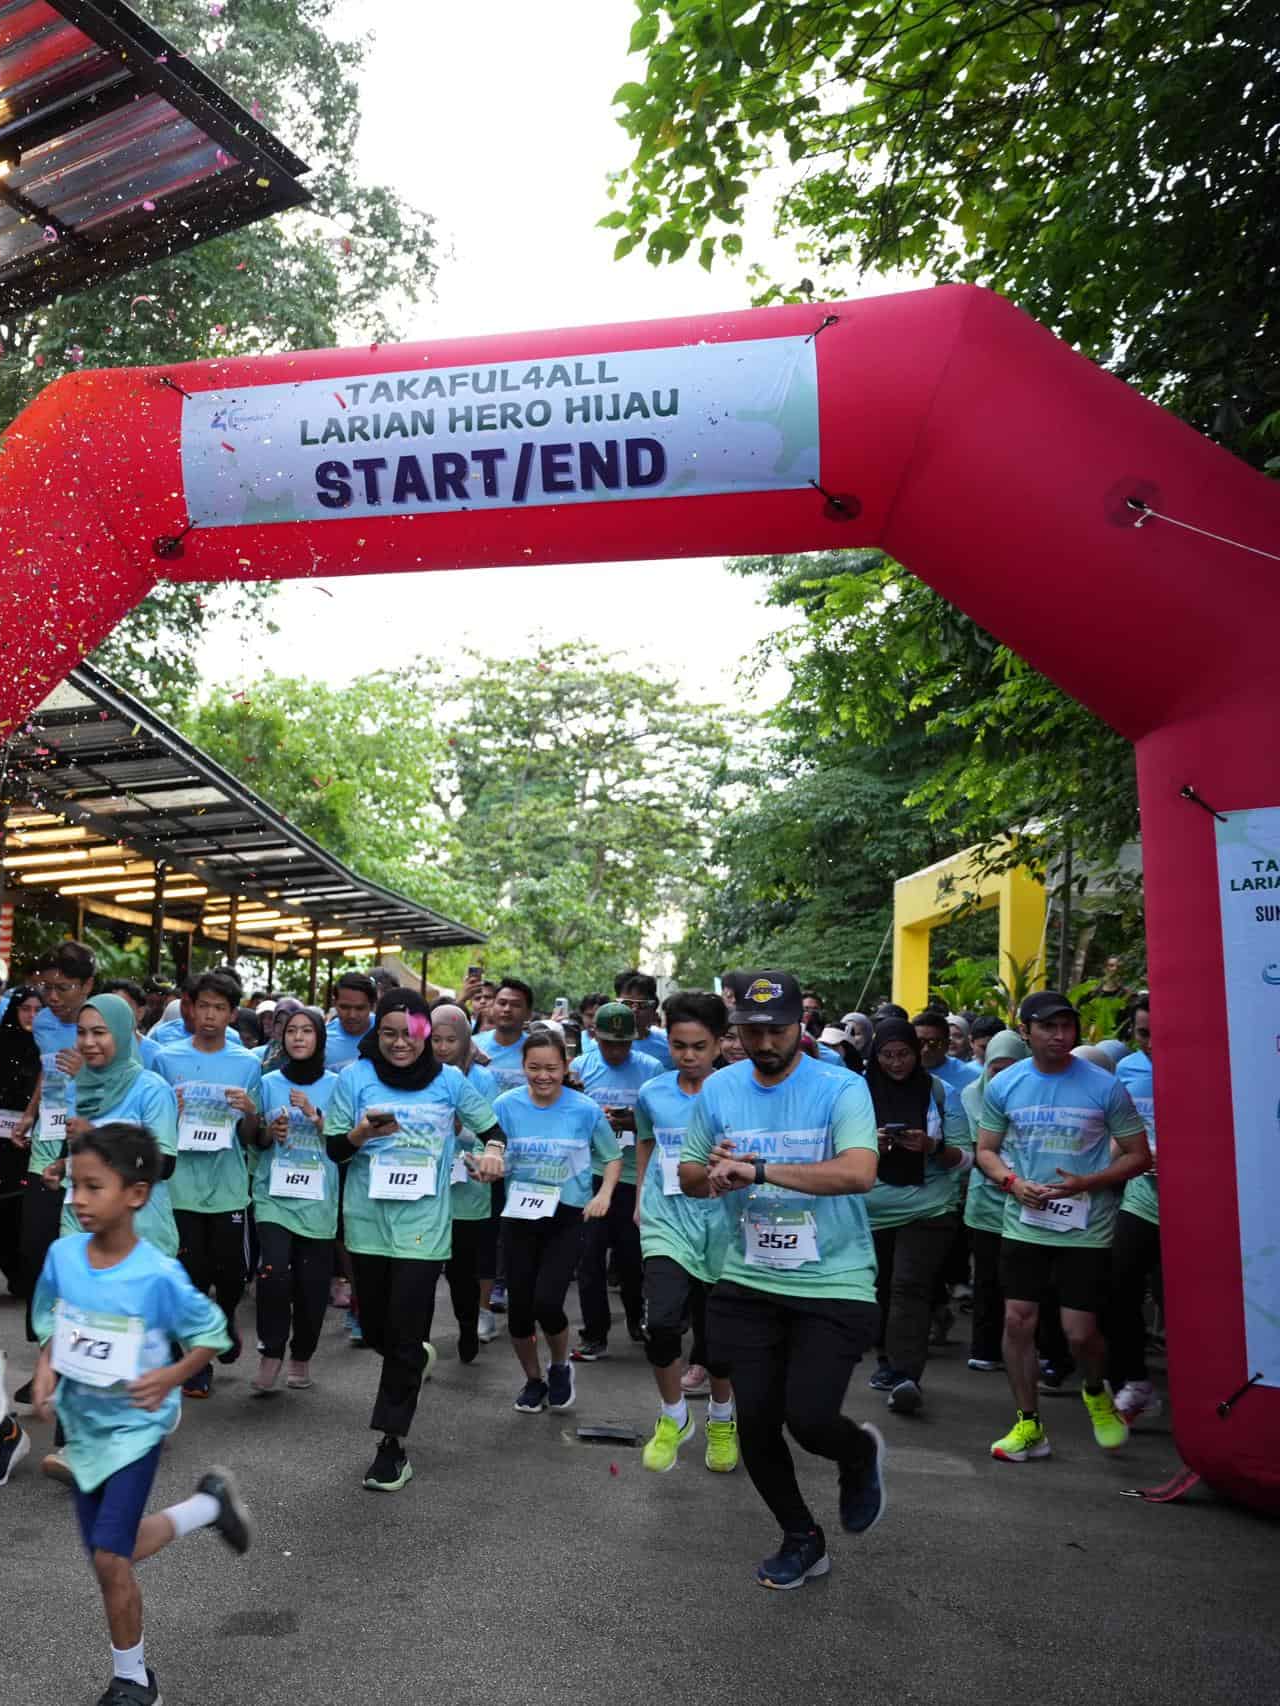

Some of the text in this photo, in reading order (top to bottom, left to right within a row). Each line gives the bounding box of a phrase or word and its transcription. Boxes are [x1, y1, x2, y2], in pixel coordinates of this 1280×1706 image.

[344, 360, 620, 408] TAKAFUL4ALL
[300, 387, 680, 447] LARIAN HERO HIJAU
[314, 436, 668, 509] START/END
[50, 1115, 66, 1127] 30
[193, 1130, 217, 1142] 100
[285, 1173, 311, 1186] 164
[388, 1172, 419, 1186] 102
[520, 1197, 545, 1209] 174
[758, 1233, 799, 1250] 252
